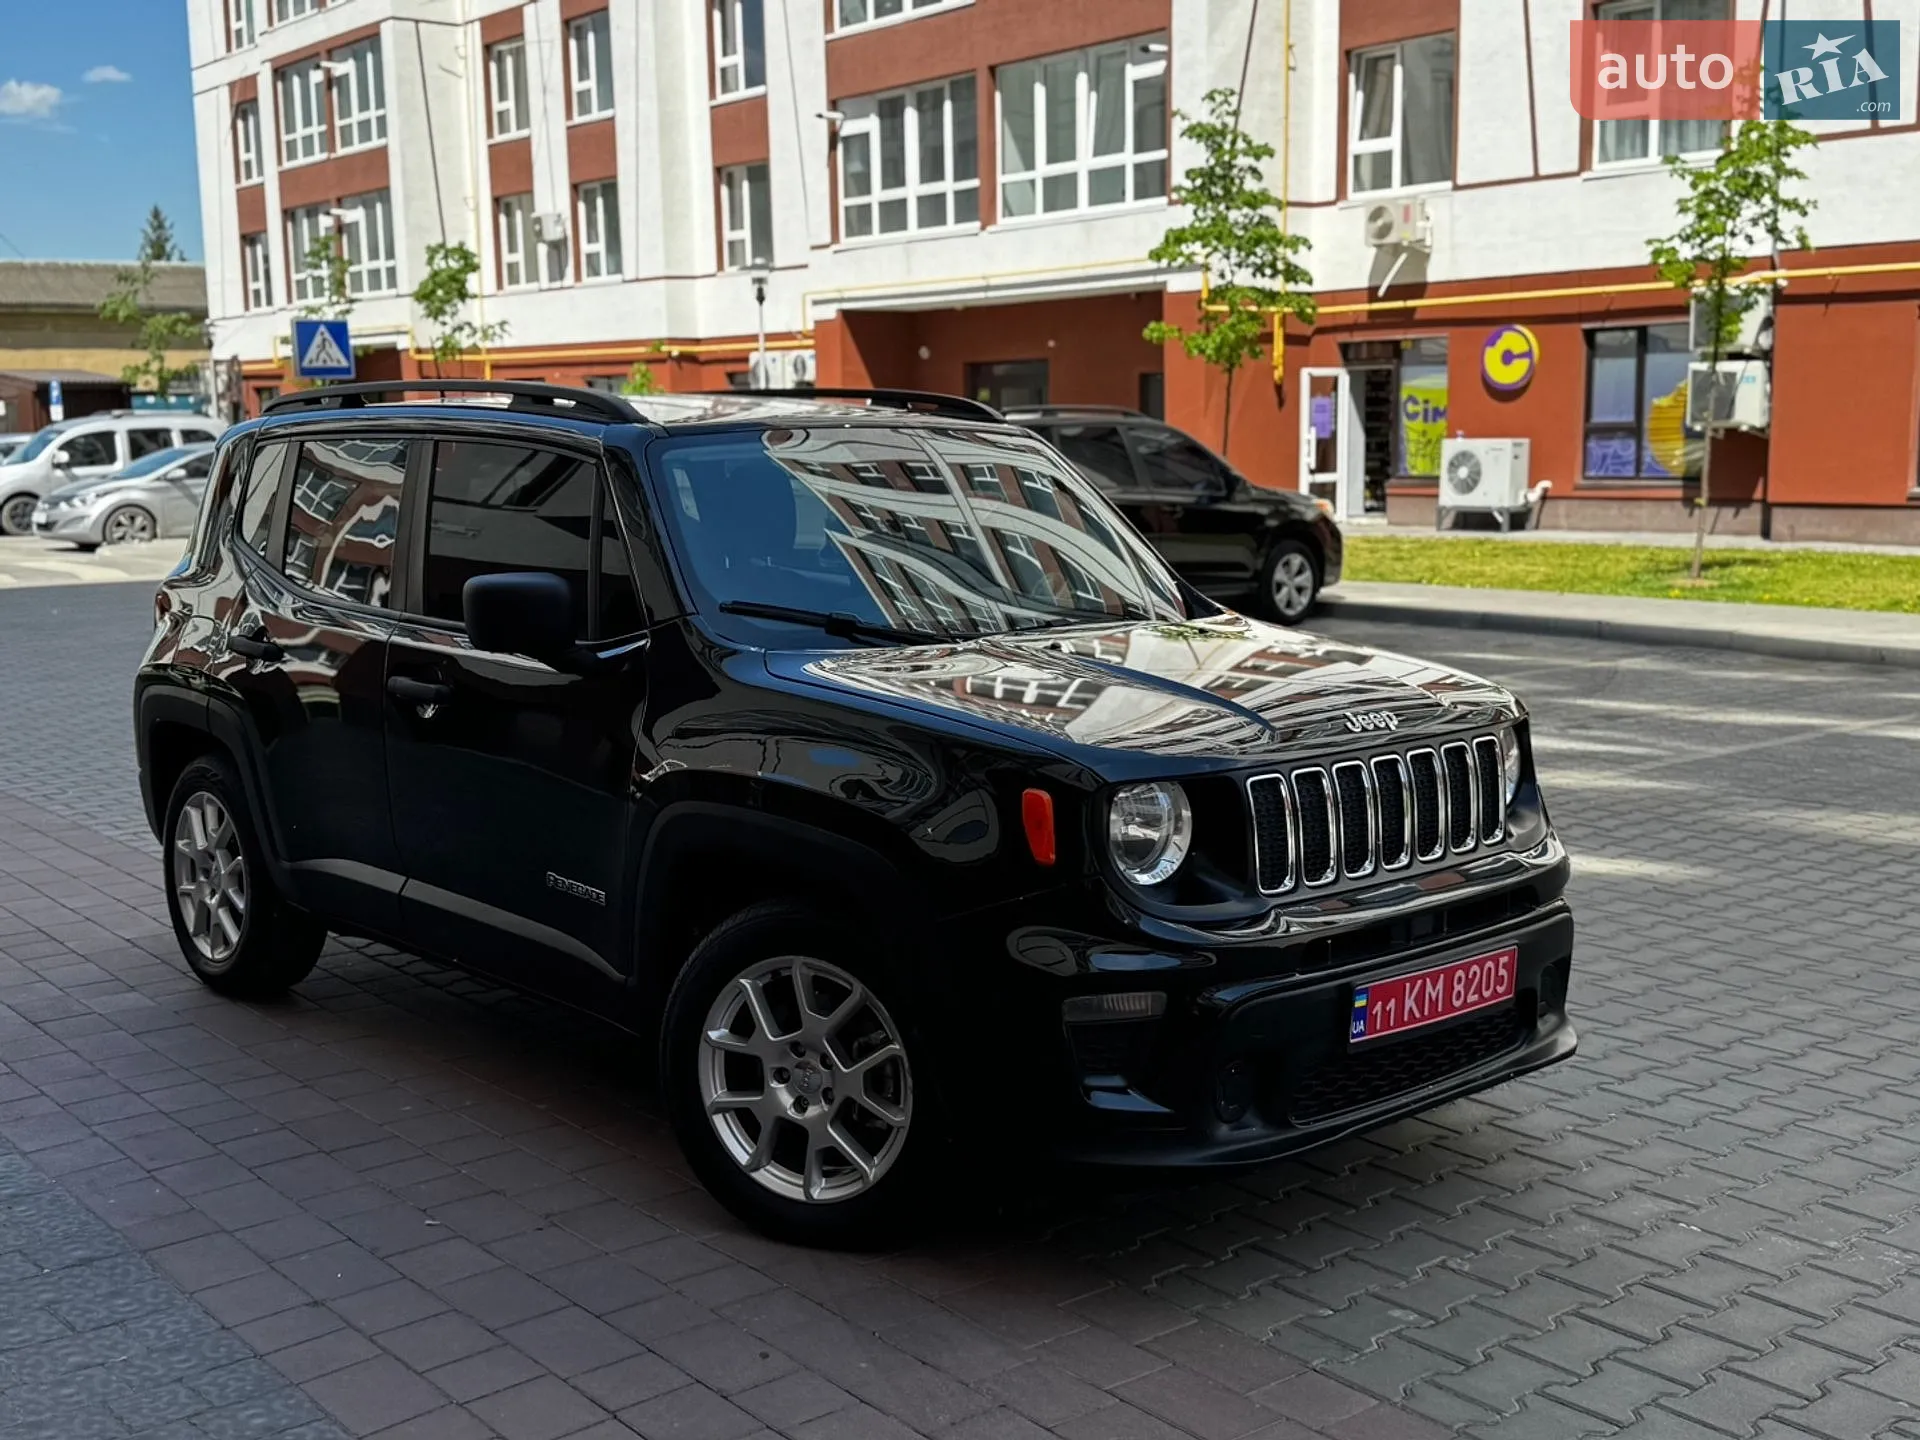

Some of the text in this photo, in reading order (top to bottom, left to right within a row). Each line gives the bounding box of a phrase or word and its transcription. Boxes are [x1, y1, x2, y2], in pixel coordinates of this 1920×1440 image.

[1343, 710, 1399, 732] Jeep
[546, 871, 606, 906] RENEGADE
[1372, 955, 1509, 1030] 11 KM 8205
[1352, 1020, 1365, 1034] UA
